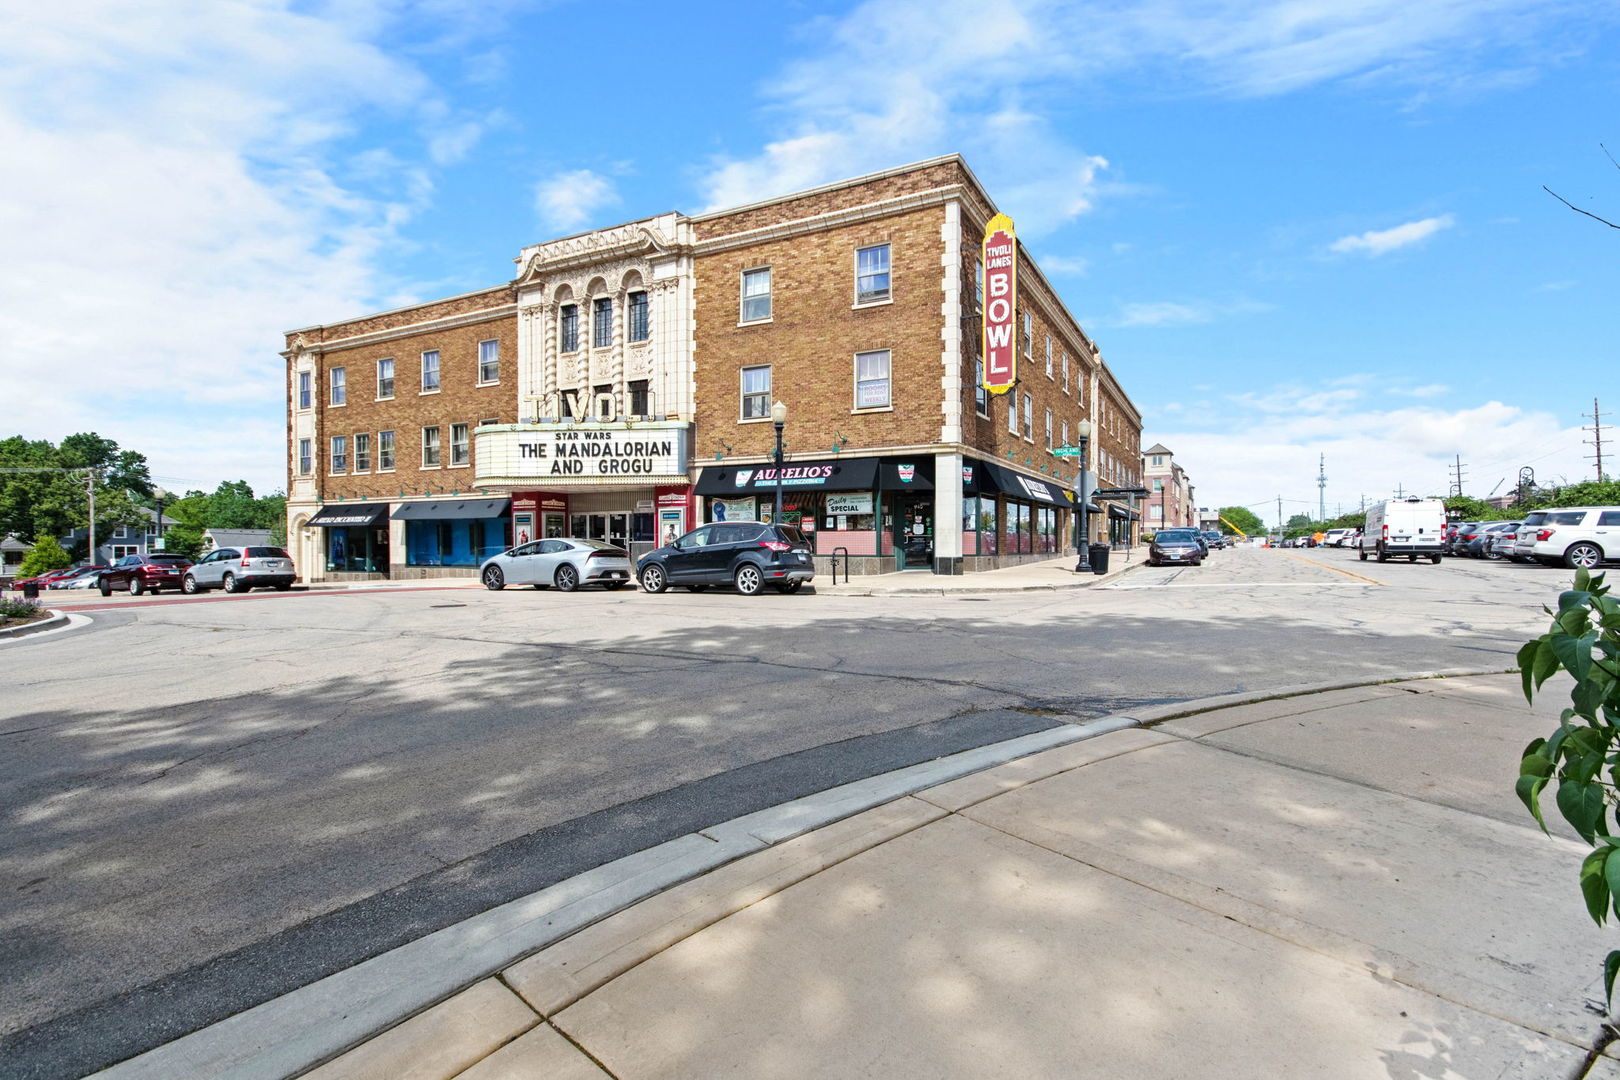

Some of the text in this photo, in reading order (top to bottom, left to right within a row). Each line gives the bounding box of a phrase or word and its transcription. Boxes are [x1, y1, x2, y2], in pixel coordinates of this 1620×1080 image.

[987, 245, 1011, 257] TIVOLI
[987, 256, 1011, 270] LANES
[986, 273, 1012, 374] BOWL
[524, 392, 656, 424] TIVOLI
[555, 432, 612, 440] STAR WARS
[519, 441, 671, 458] THE MANDALORIAN
[551, 458, 653, 475] AND GROGU
[828, 496, 847, 506] Daily
